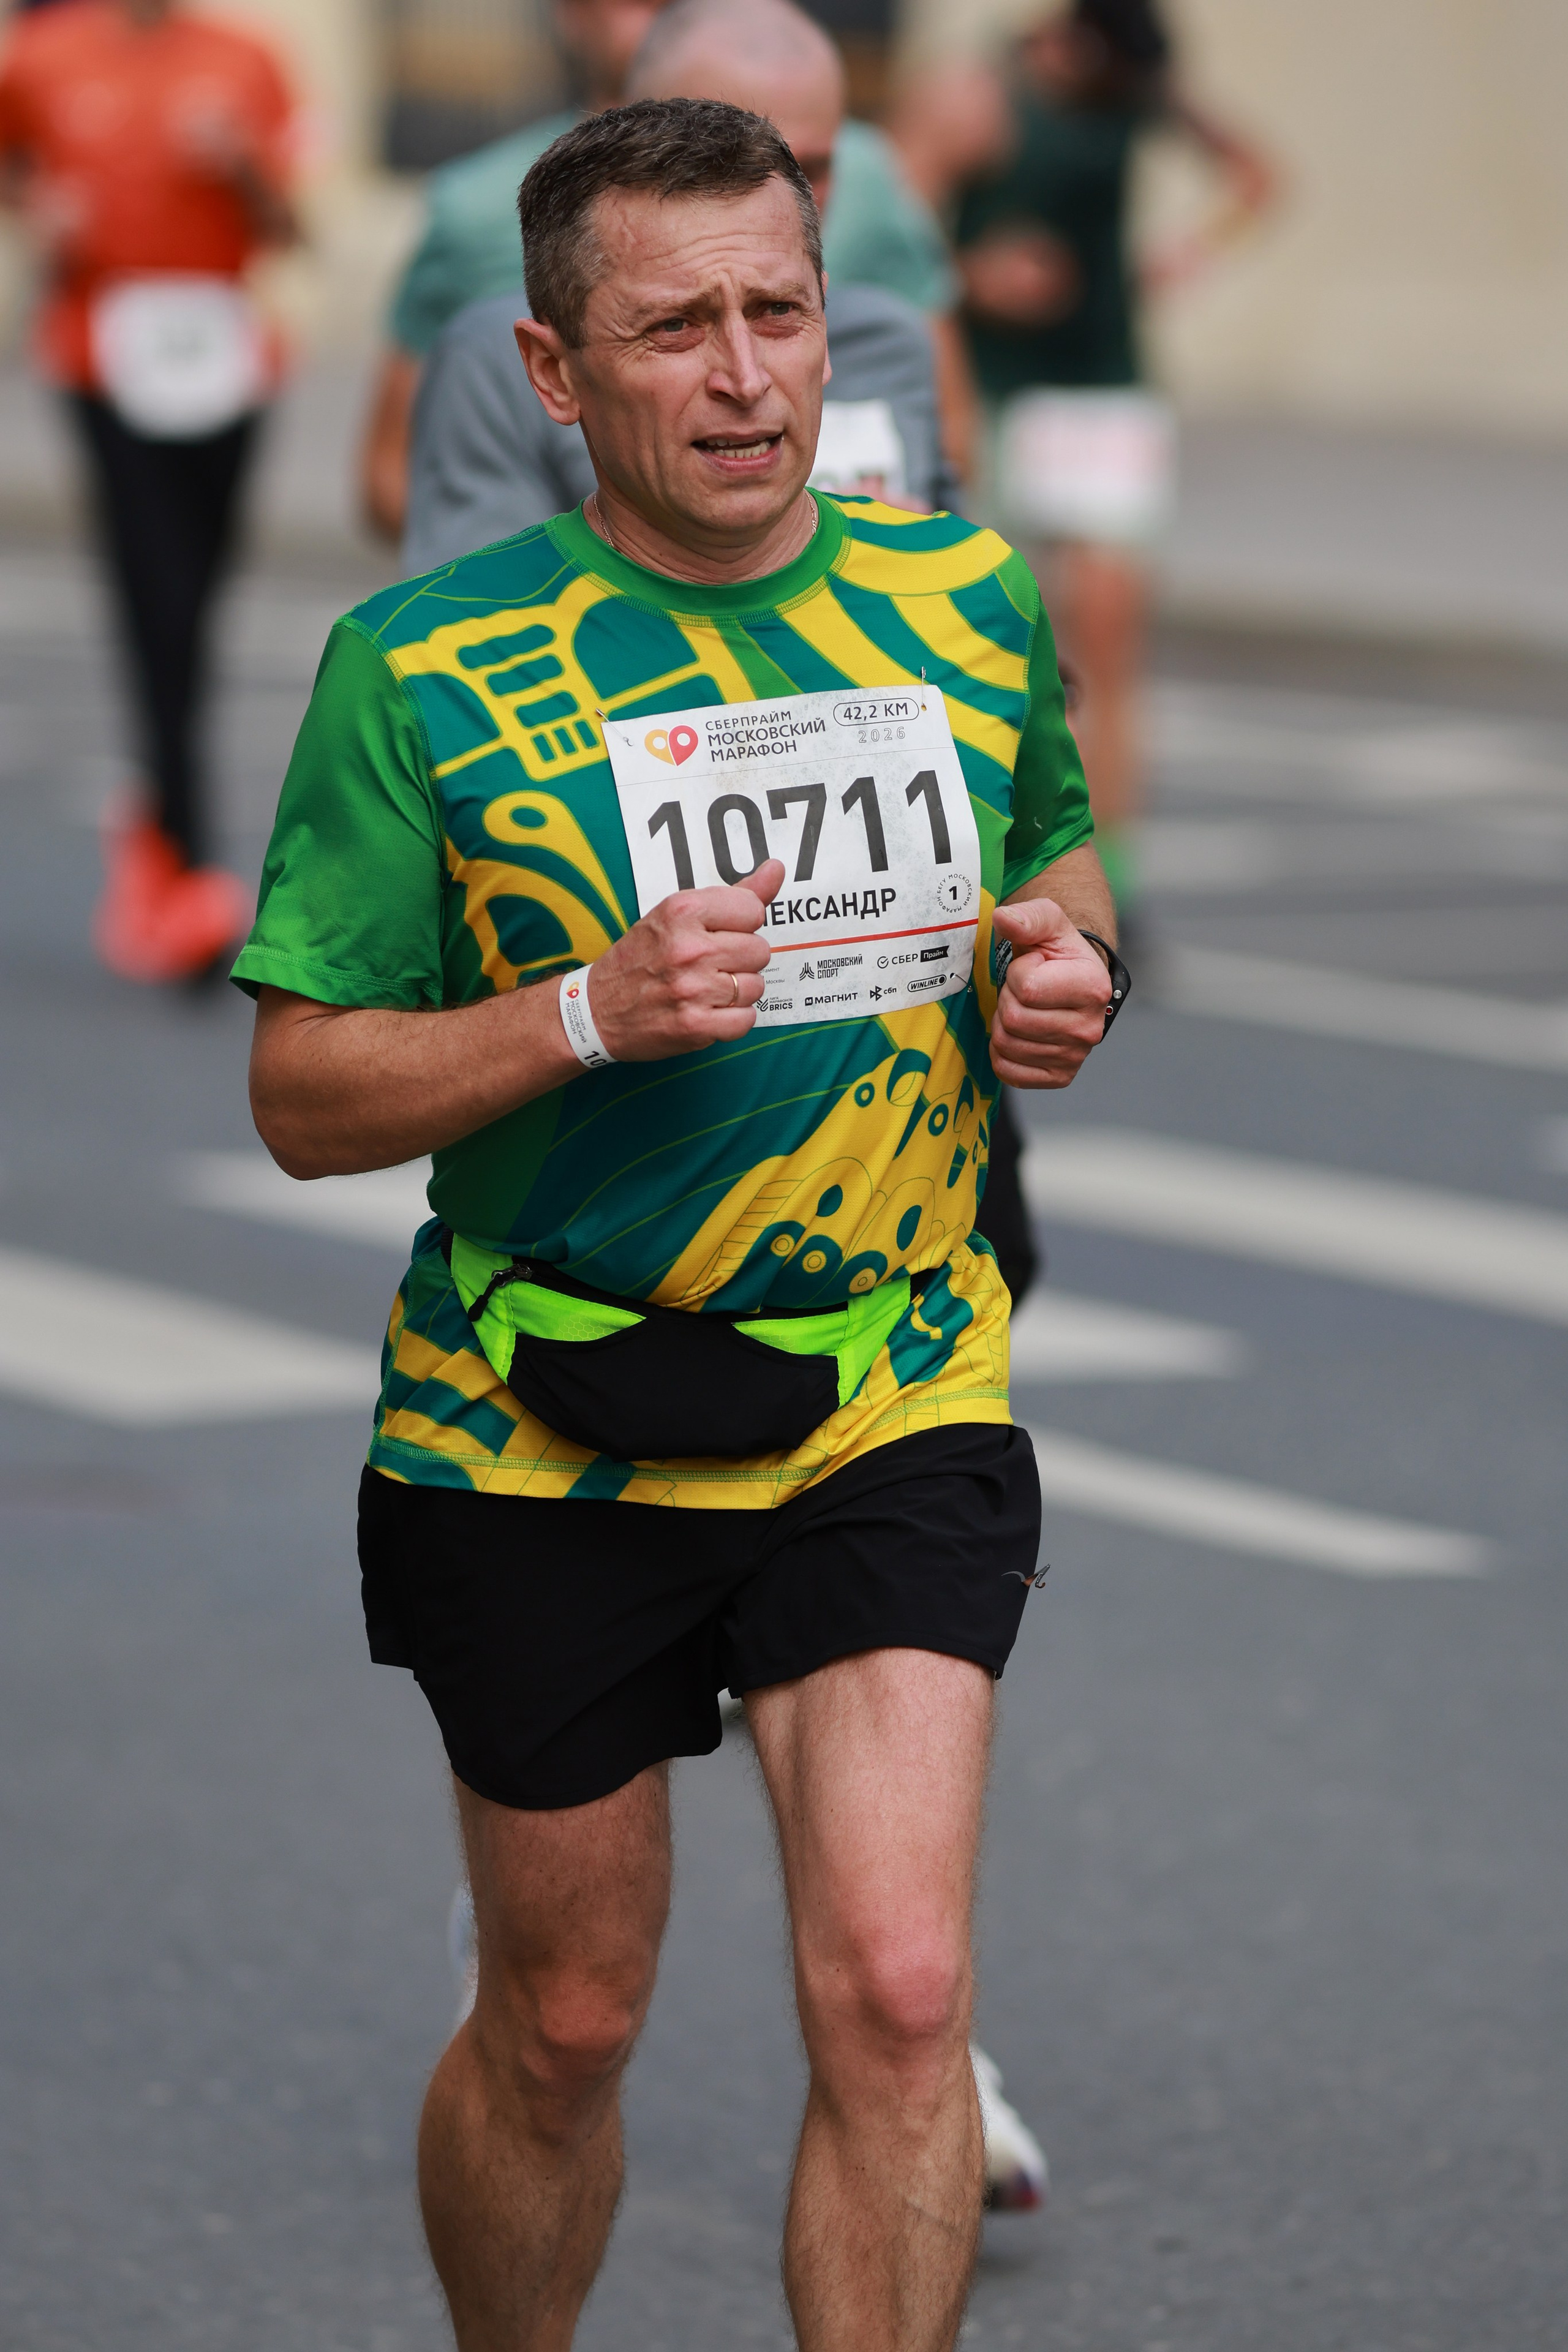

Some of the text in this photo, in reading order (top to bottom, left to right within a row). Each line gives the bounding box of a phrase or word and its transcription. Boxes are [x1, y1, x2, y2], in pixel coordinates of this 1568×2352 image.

[705, 710, 792, 731] СБЕРПРАЙМ
[843, 703, 908, 721] 42,2 КМ
[707, 717, 826, 747] МОСКОВСКИЙ
[858, 726, 905, 743] 2026
[710, 740, 797, 762] МАРАФОН
[647, 769, 952, 893] 10711
[948, 886, 957, 900] 1
[817, 954, 863, 969] МОСКОВСКИЙ
[892, 950, 944, 965] СБЕР Прайм
[818, 968, 839, 979] СПОРТ
[910, 978, 938, 990] WINLINE
[769, 1002, 793, 1011] BRICS
[565, 1003, 577, 1035] МАРАФОН
[570, 1001, 587, 1044] МОСКОВСКИЙ
